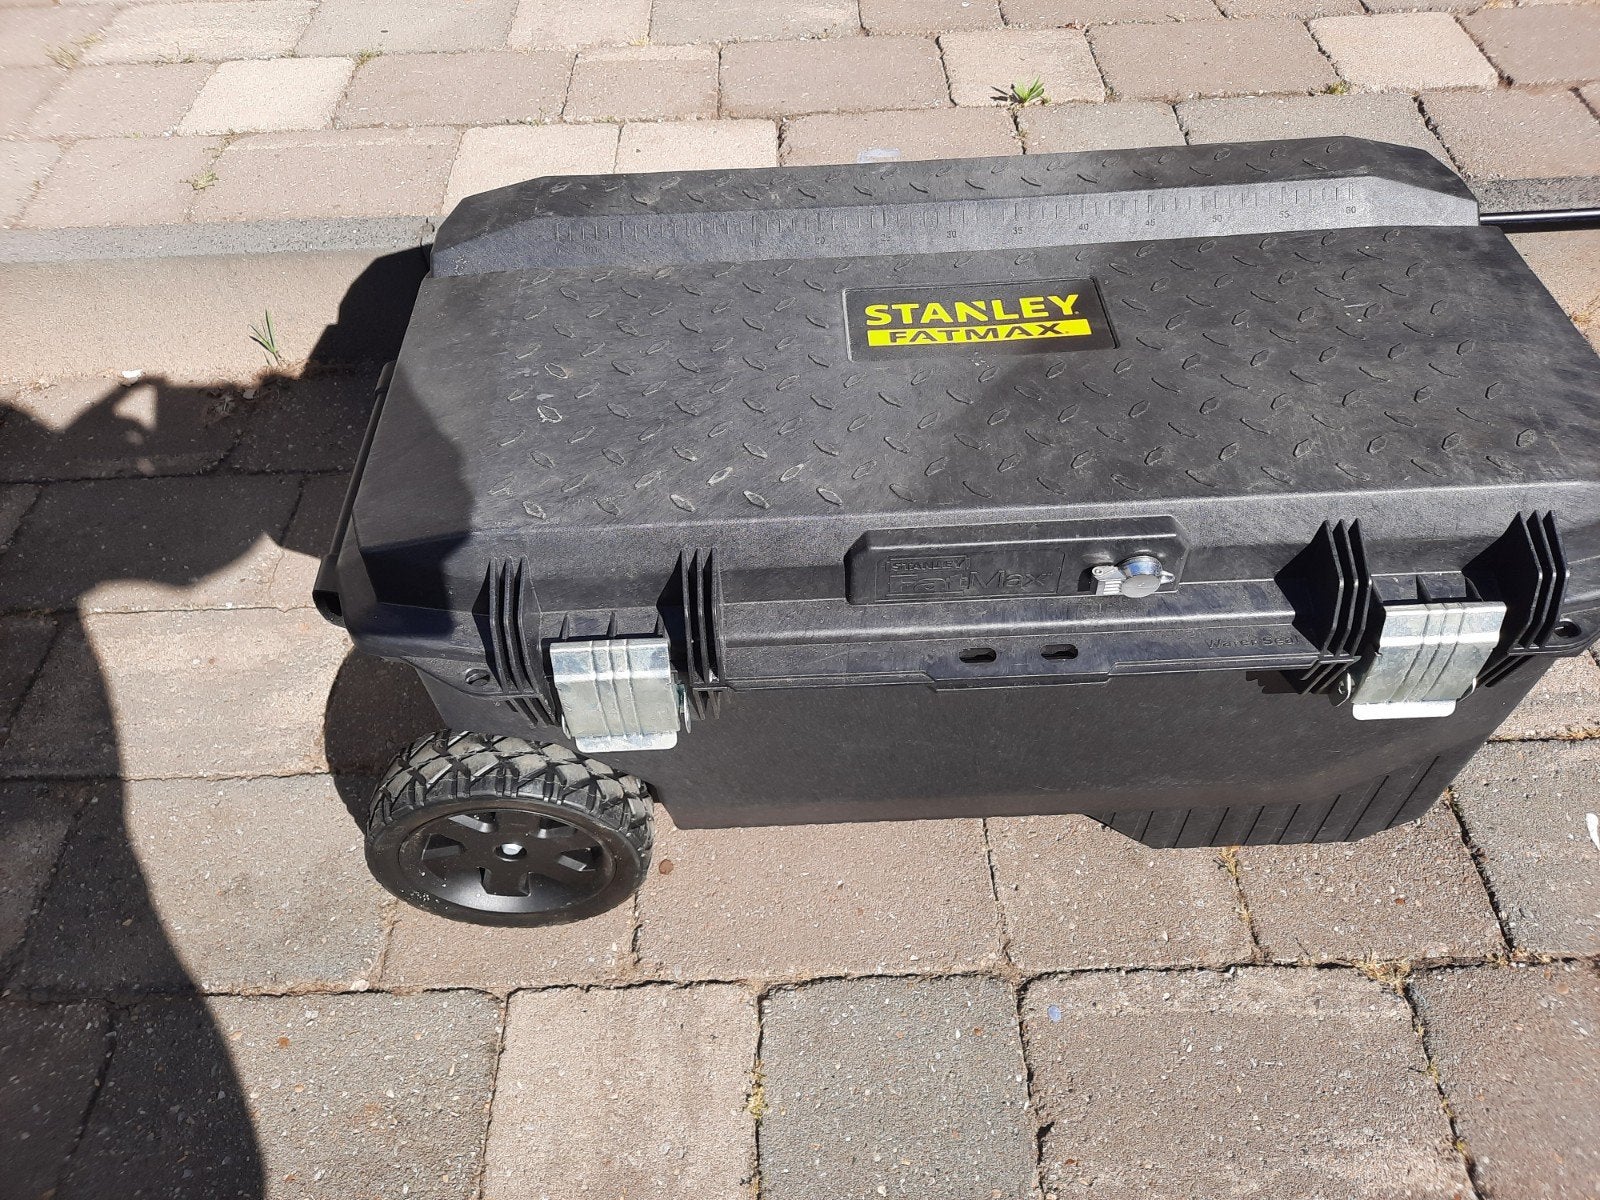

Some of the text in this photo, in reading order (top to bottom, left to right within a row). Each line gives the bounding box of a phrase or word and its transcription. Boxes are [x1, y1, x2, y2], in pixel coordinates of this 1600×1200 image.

[864, 294, 1079, 326] STANLEY
[889, 322, 1064, 343] FATMAX
[891, 557, 966, 571] STANLEY
